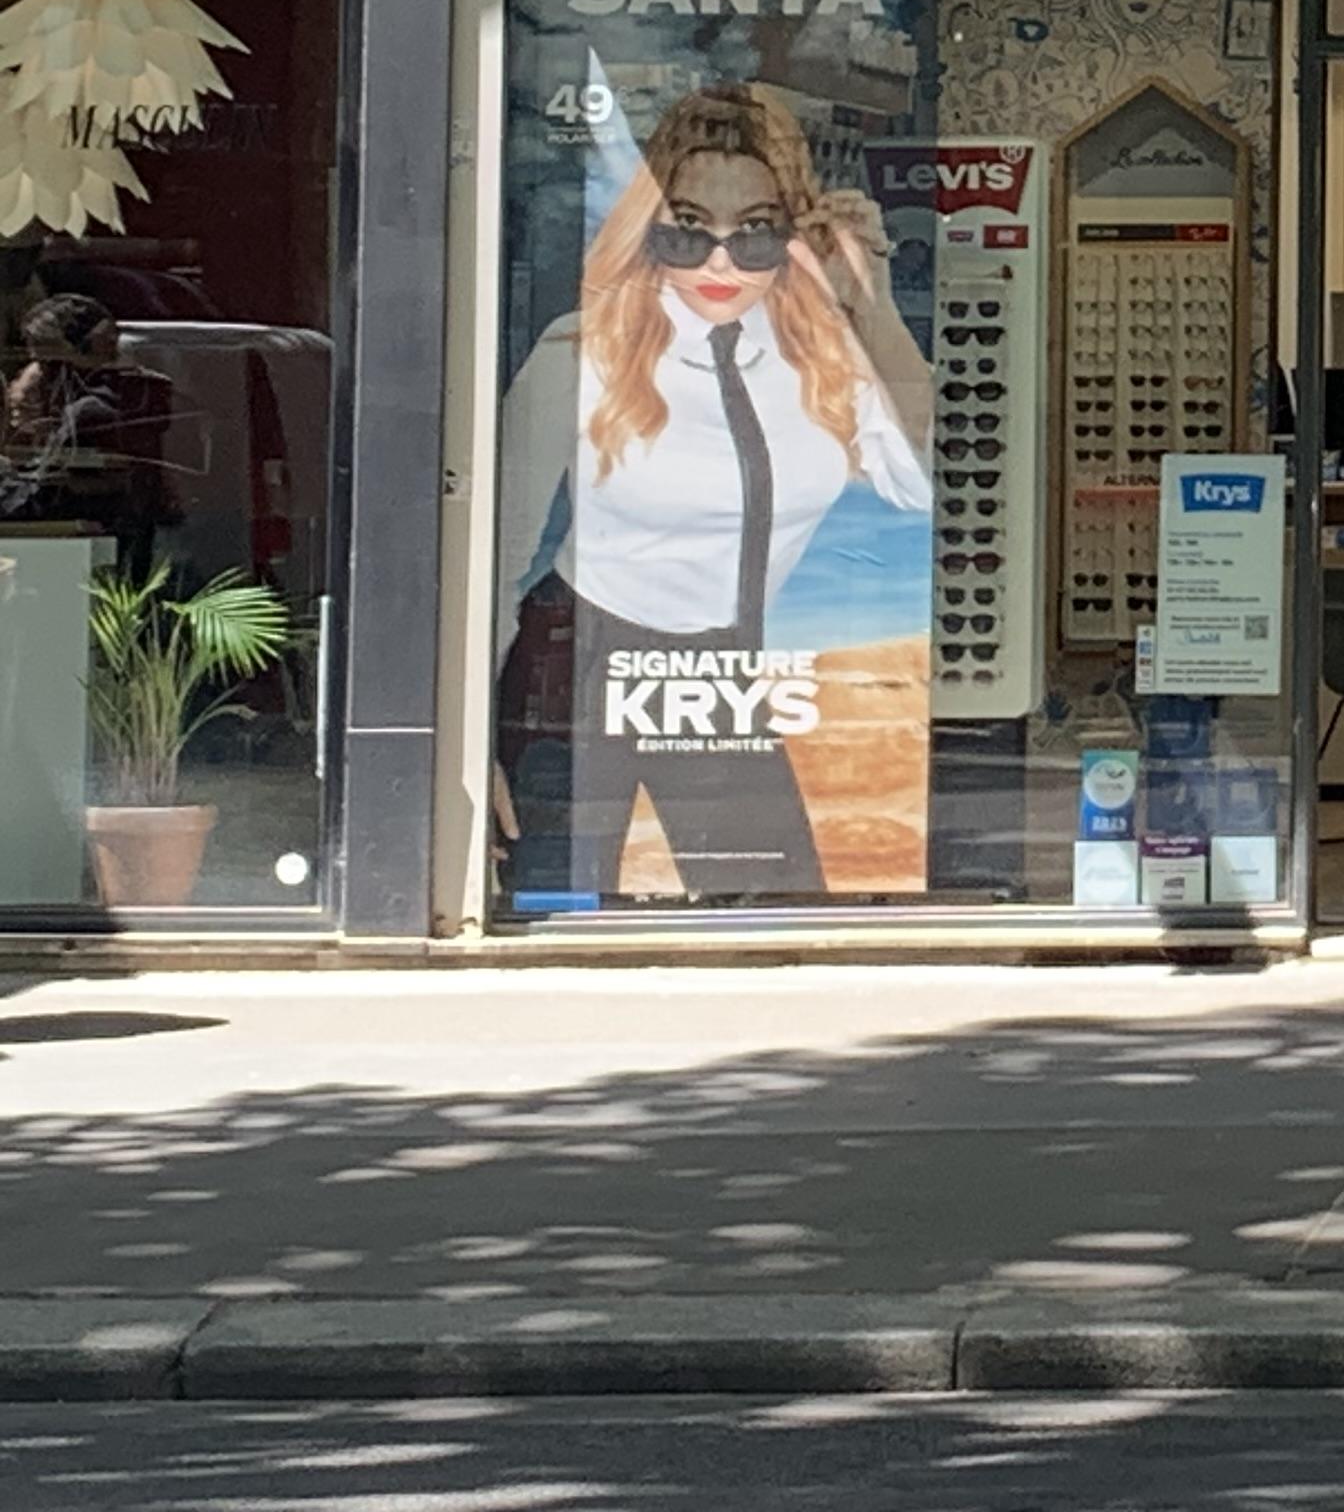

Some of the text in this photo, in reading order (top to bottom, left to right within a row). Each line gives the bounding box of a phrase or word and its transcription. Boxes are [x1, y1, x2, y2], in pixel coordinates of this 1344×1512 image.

[1194, 480, 1251, 506] Krys
[607, 650, 817, 678] SIGNATURE
[605, 679, 821, 736] KRYS
